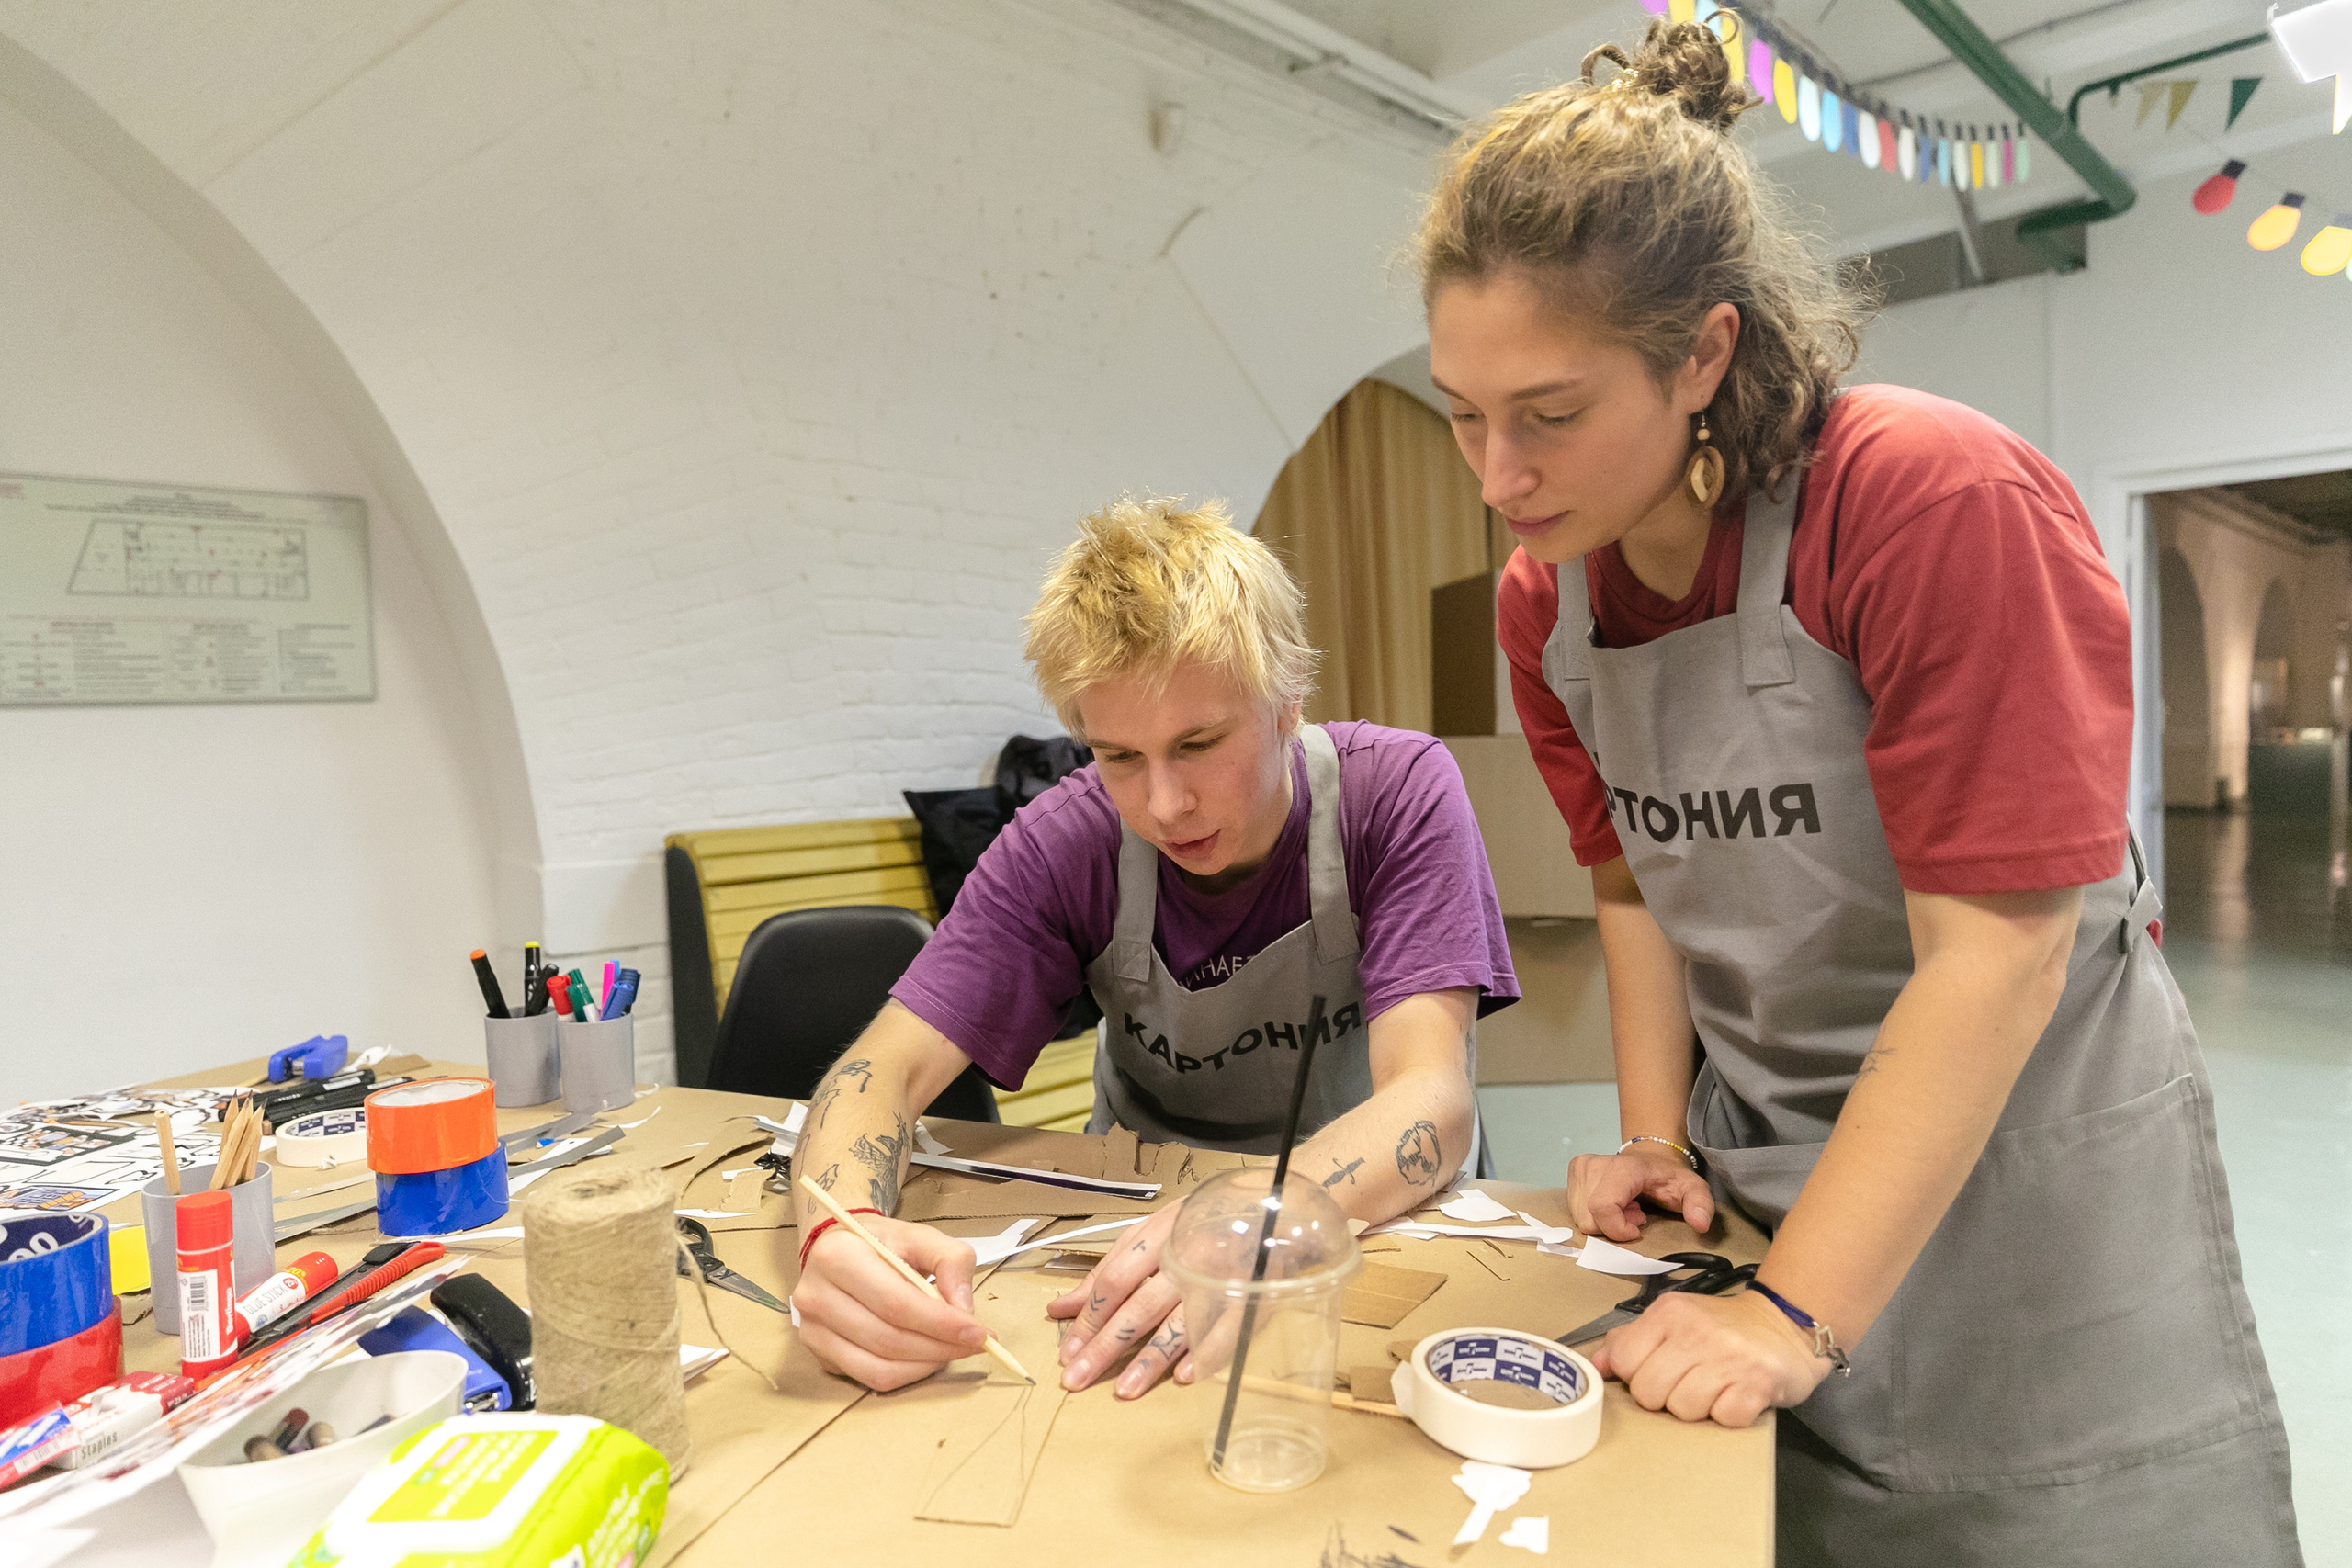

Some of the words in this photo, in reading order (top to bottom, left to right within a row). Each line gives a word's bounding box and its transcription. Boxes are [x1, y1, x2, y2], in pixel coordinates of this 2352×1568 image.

[1593, 752, 1822, 843] РТОНИЯ
[1178, 954, 1256, 987] ИНАЕ
[225, 1287, 234, 1336] Berlingo
[243, 1295, 267, 1315] GLUE
[261, 1283, 288, 1303] STICK
